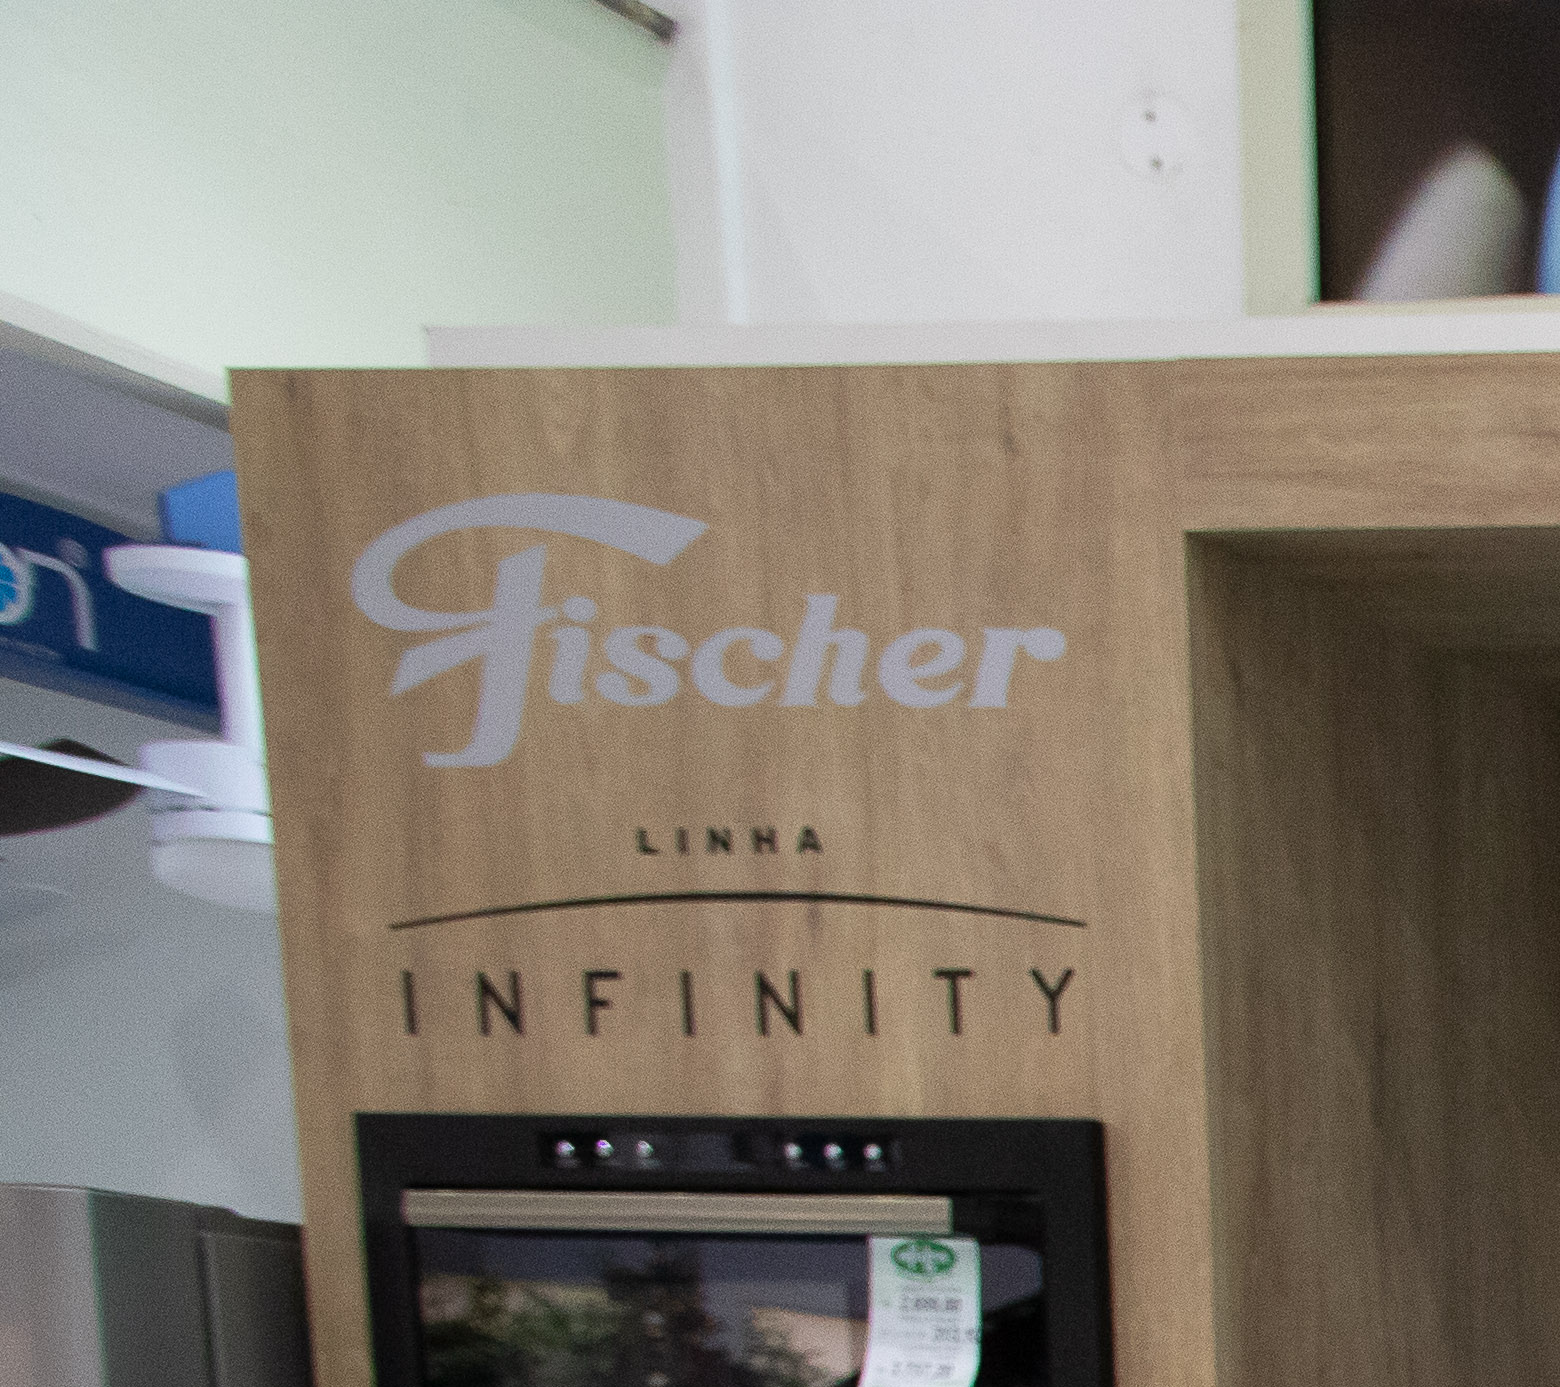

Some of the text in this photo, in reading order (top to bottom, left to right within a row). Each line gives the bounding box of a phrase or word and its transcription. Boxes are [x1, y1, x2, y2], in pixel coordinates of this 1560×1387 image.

[351, 493, 1066, 768] Fischer
[636, 827, 823, 855] LINHA
[401, 967, 1076, 1037] INFINITY
